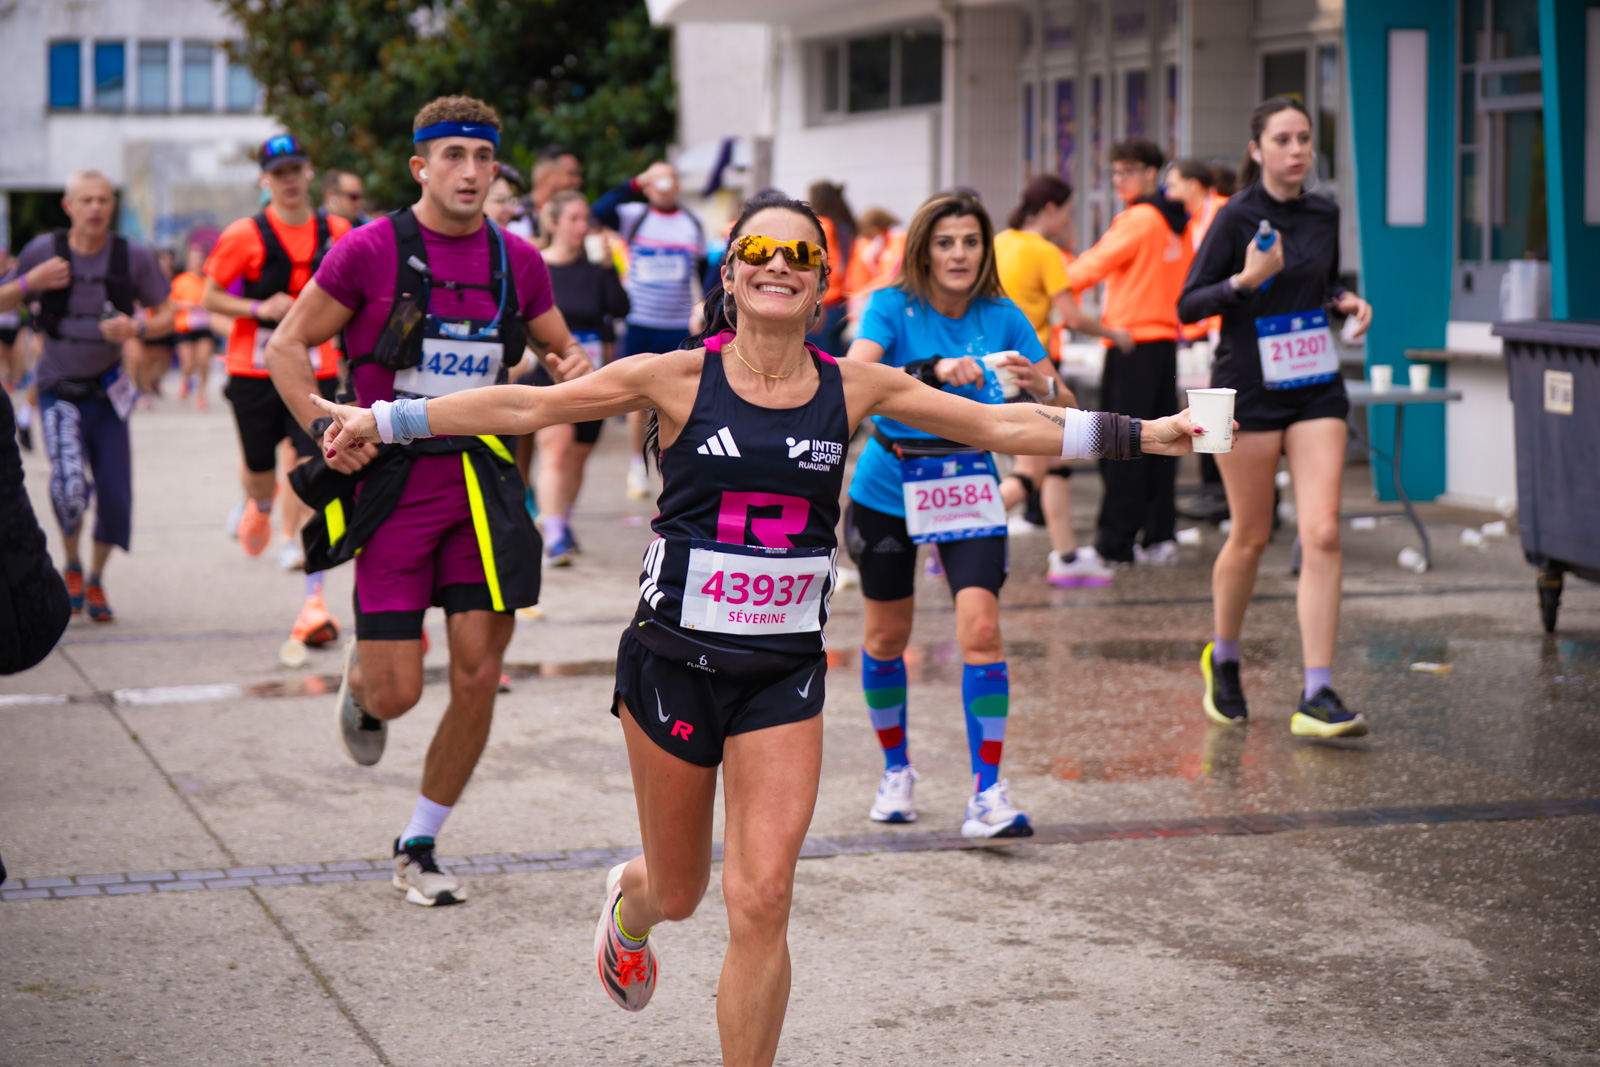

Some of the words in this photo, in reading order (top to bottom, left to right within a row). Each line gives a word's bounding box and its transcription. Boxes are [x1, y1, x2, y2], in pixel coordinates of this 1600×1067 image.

[1270, 334, 1327, 362] 21207
[812, 439, 843, 455] INTER
[798, 460, 831, 472] RUAUDIN
[811, 451, 841, 465] SPORT
[915, 482, 993, 511] 20584
[716, 490, 811, 549] R
[701, 570, 815, 607] 43937
[728, 609, 787, 624] SÉVERINE
[686, 661, 717, 674] FLIPBELT
[670, 719, 694, 742] R
